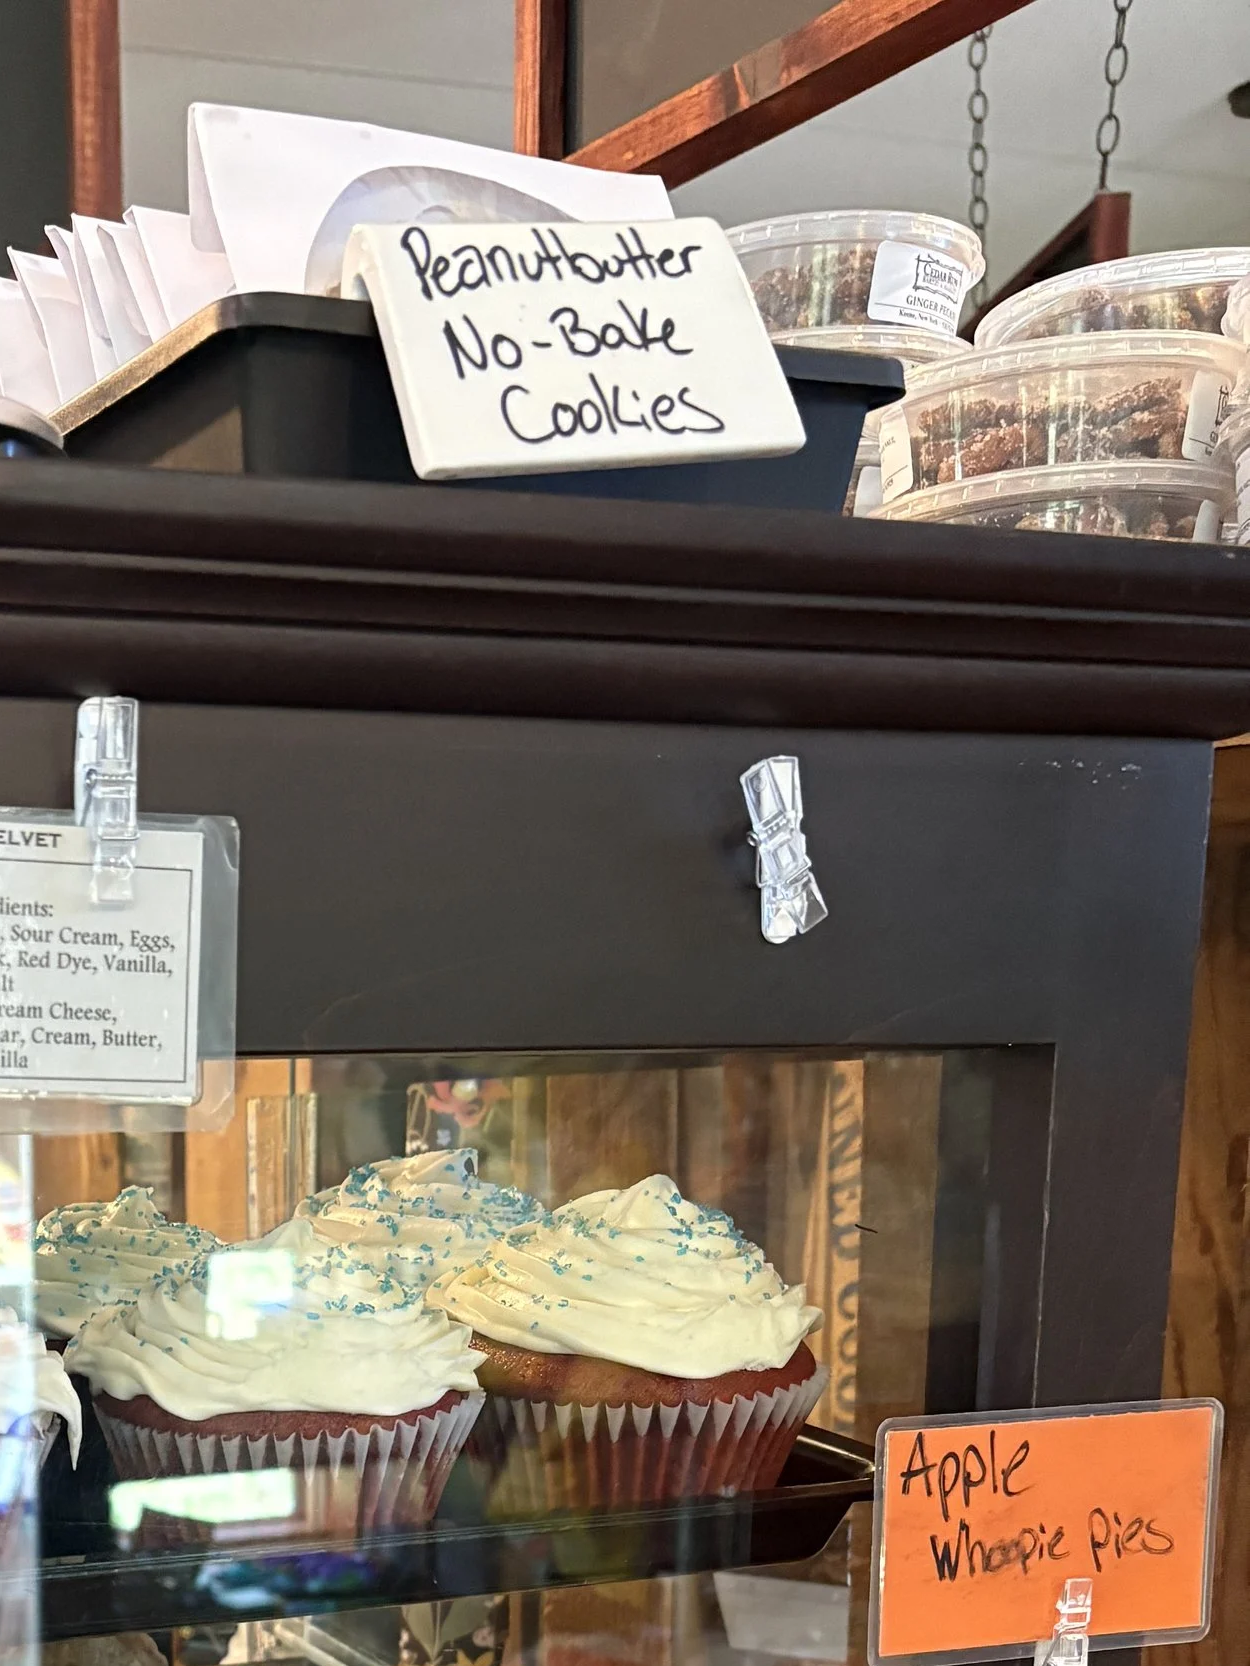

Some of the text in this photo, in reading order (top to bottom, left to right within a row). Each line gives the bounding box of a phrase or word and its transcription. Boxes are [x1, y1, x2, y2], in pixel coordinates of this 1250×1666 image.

[401, 226, 703, 301] Peanutbutter
[906, 294, 939, 312] GINGER
[442, 299, 694, 379] No-Bake
[500, 372, 726, 444] Cookies
[10, 924, 55, 944] Sour
[59, 927, 124, 949] Cream,
[130, 930, 177, 953] Eggs,
[17, 950, 52, 970] Red
[57, 952, 98, 975] Dye,
[103, 954, 174, 978] Vanilla,
[49, 1003, 118, 1024] Cheese,
[31, 1028, 96, 1049] Cream,
[102, 1030, 163, 1051] Butter,
[901, 1430, 1036, 1521] Apple
